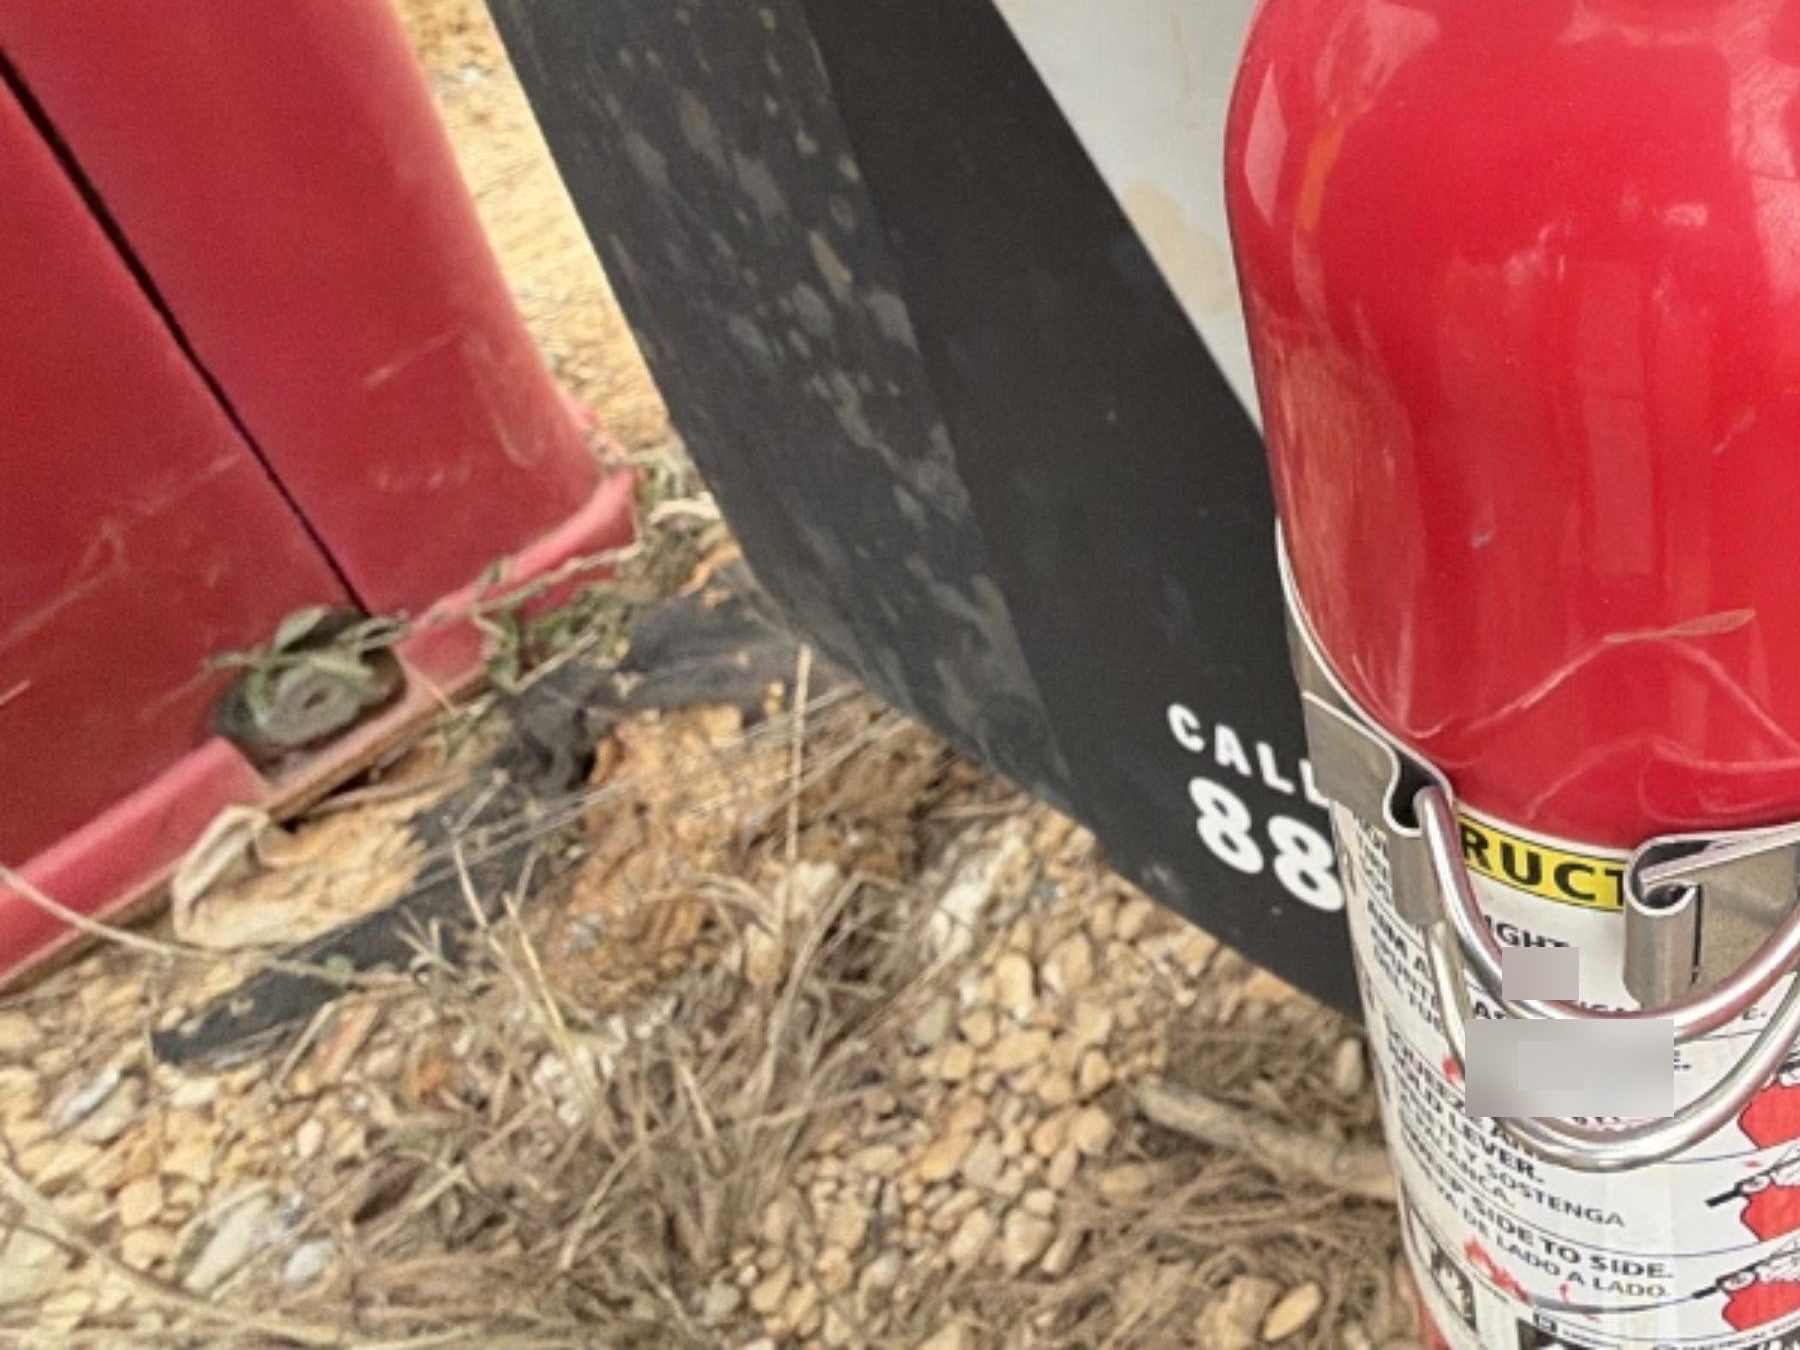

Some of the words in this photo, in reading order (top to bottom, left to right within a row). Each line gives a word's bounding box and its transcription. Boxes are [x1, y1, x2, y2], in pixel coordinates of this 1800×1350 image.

[1167, 703, 1330, 809] CALL
[1485, 1160, 1626, 1227] SOSTENGA
[1471, 1195, 1535, 1248] SIDE
[1541, 1238, 1581, 1265] TO
